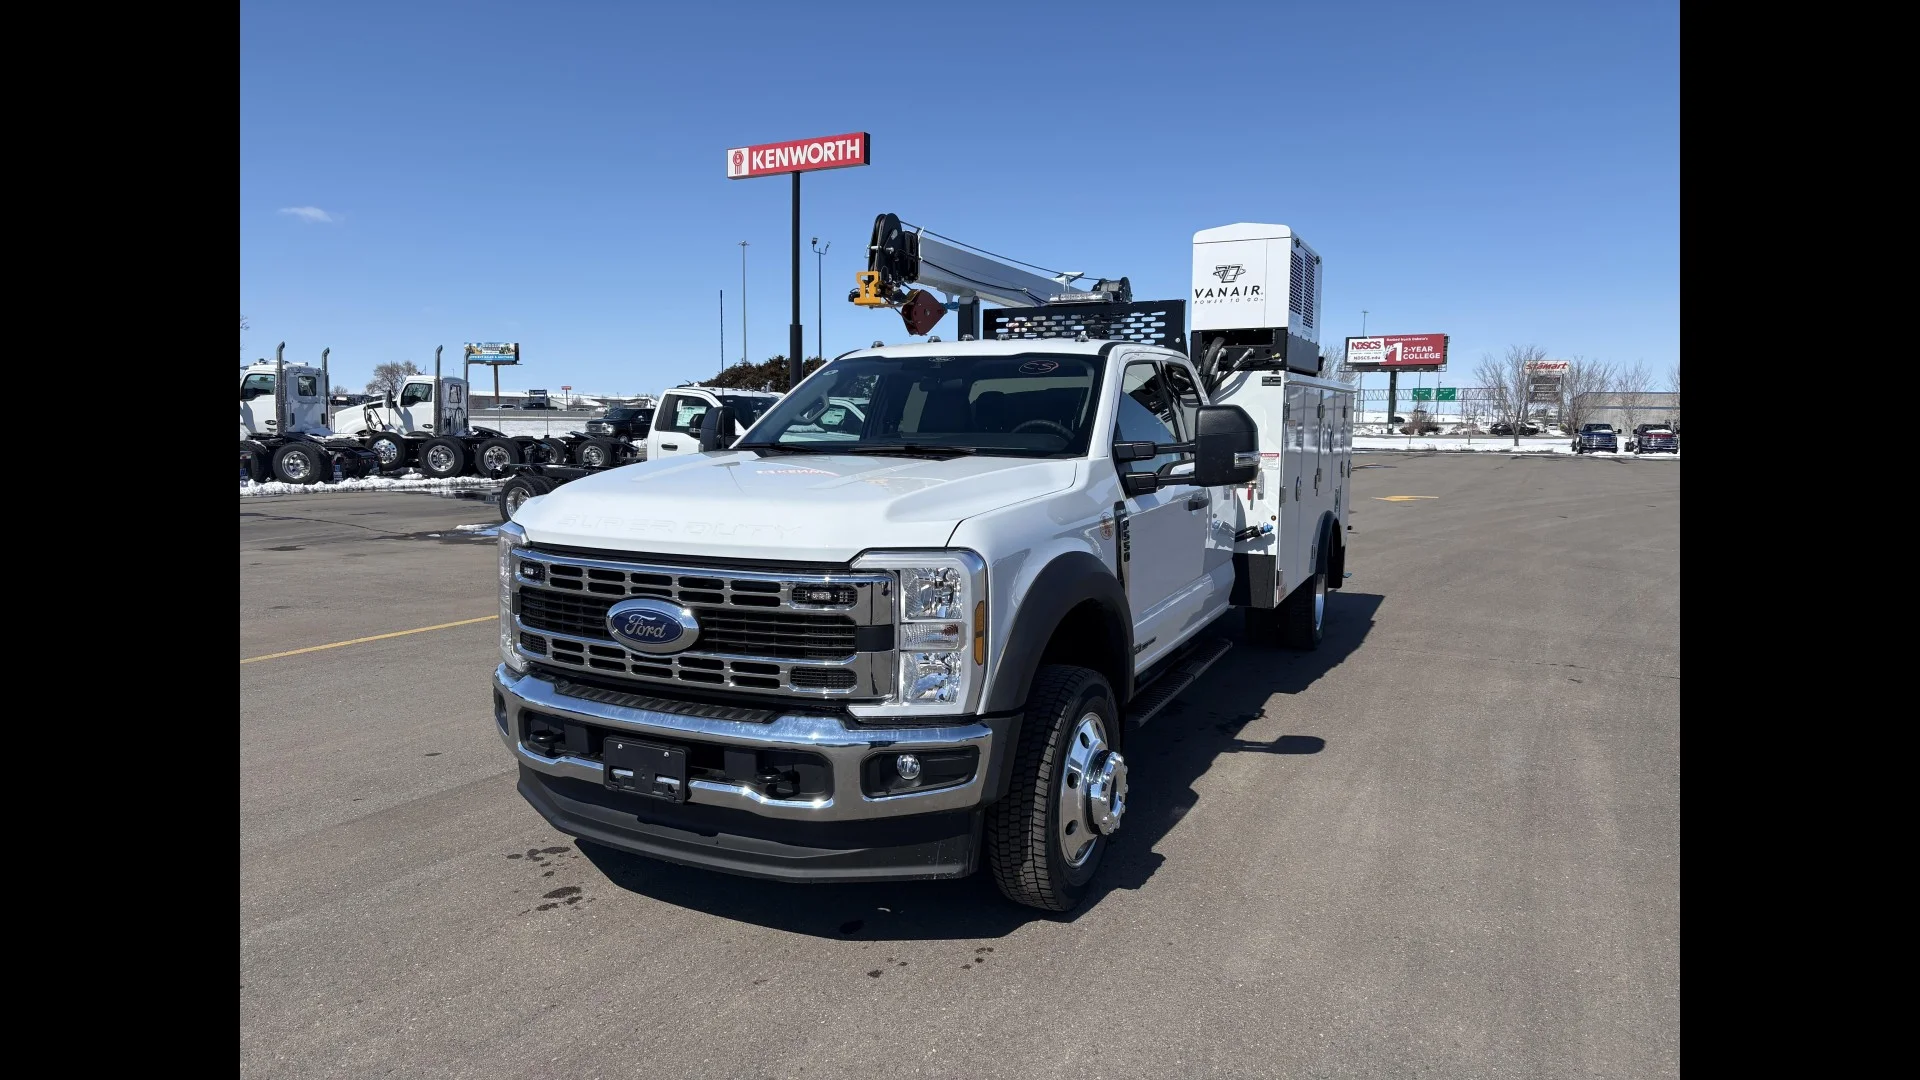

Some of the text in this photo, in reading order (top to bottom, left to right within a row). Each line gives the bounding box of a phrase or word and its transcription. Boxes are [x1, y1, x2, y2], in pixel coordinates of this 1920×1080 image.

[752, 138, 860, 171] KENWORTH
[557, 512, 803, 541] SUPER DUTY
[624, 613, 668, 639] Ford
